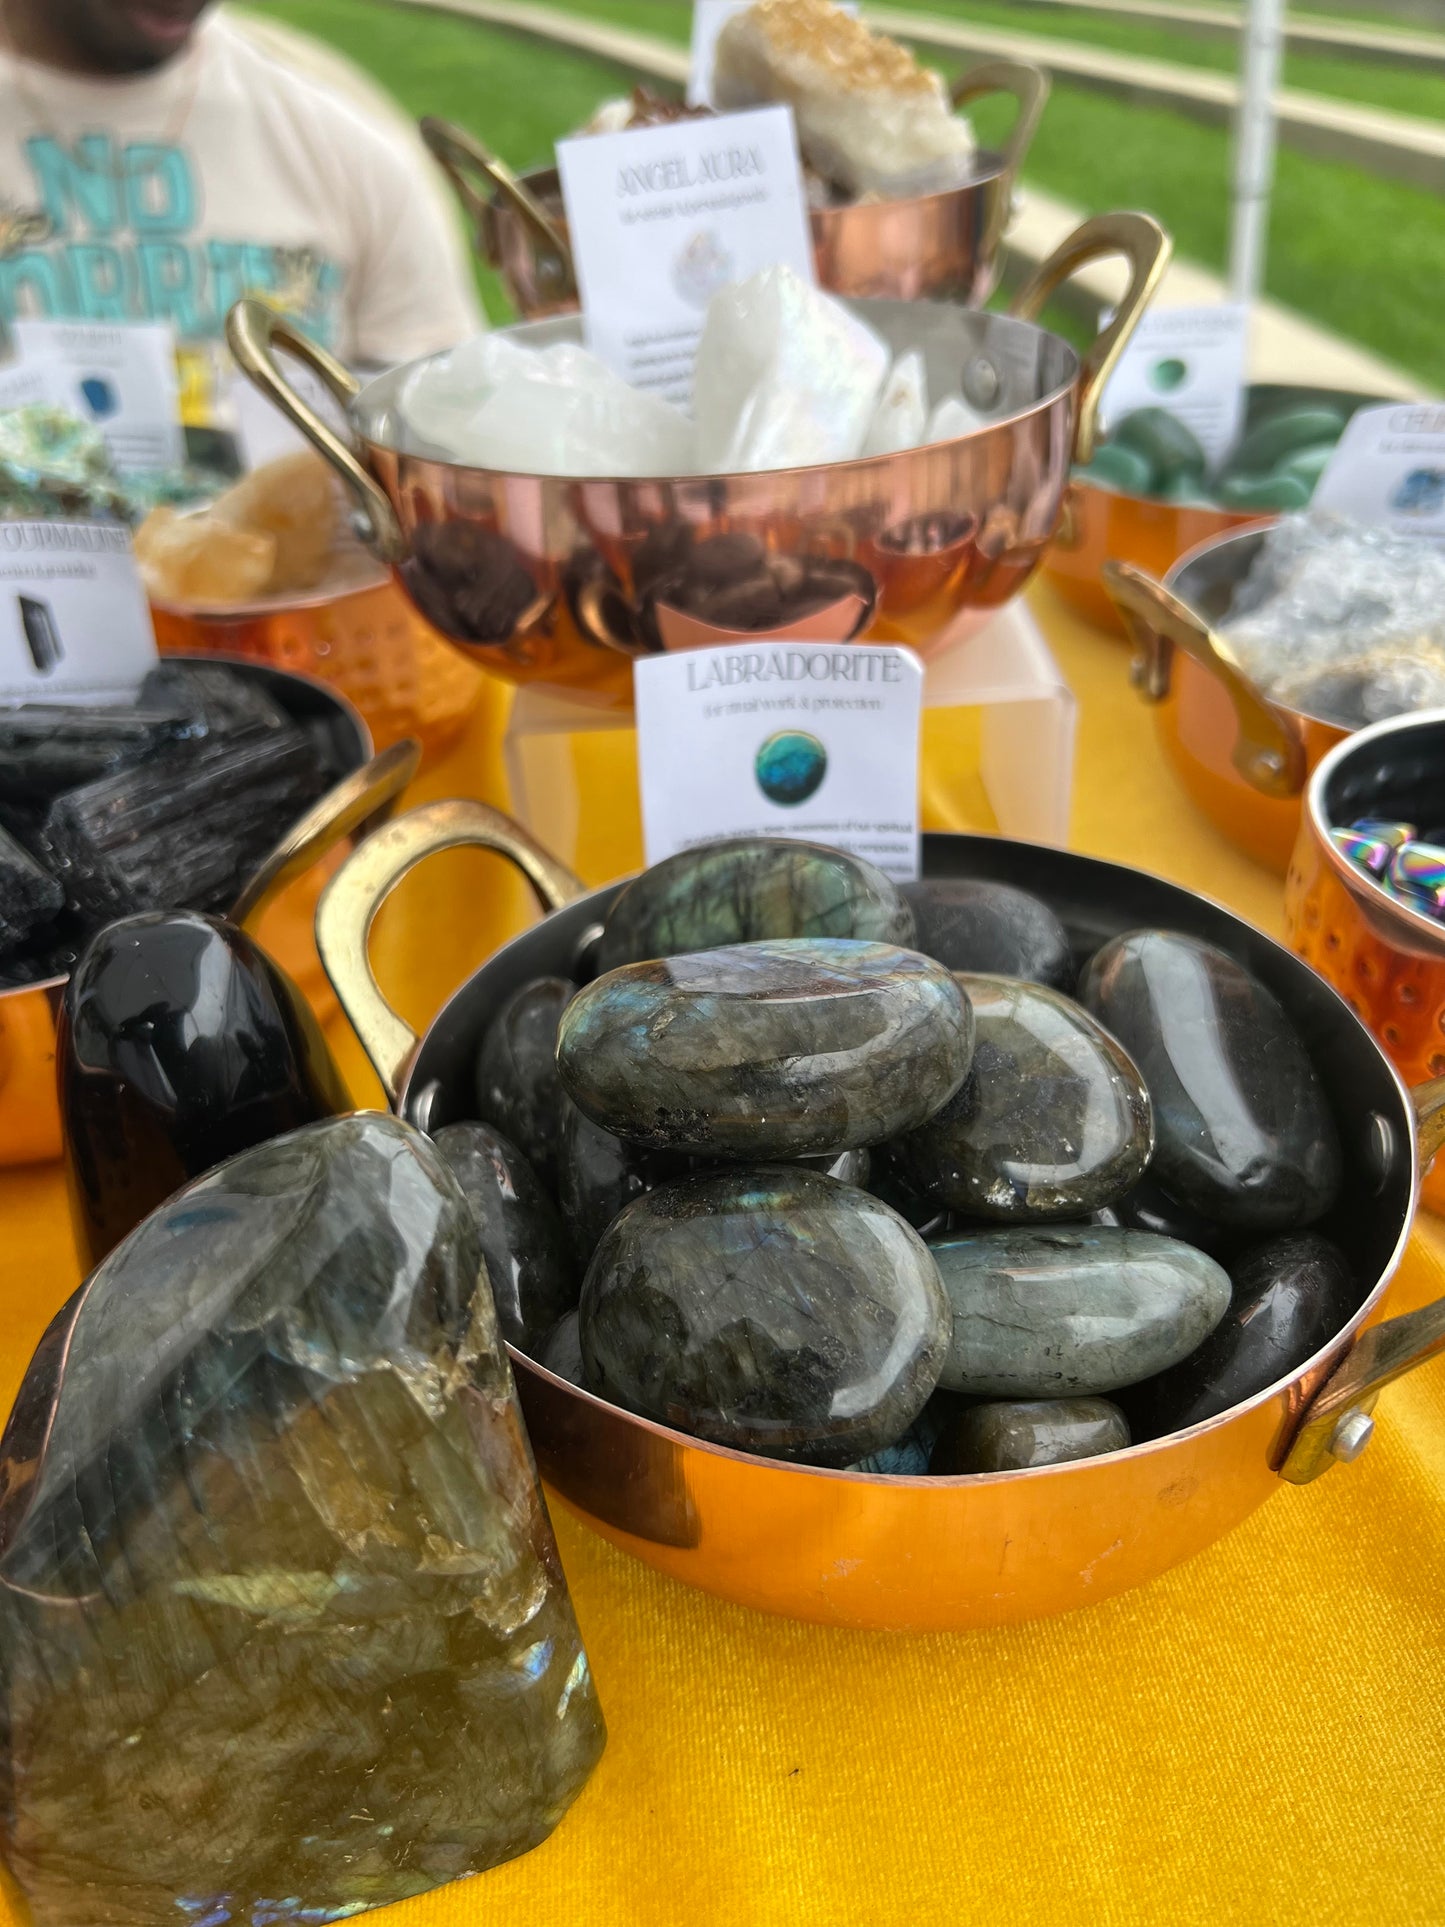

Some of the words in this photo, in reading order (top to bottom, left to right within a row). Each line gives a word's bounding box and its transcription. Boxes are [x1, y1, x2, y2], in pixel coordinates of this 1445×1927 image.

[25, 129, 196, 236] NO
[616, 153, 696, 198] ANGEL
[699, 146, 767, 184] AURA
[687, 650, 904, 692] LABRADORITE
